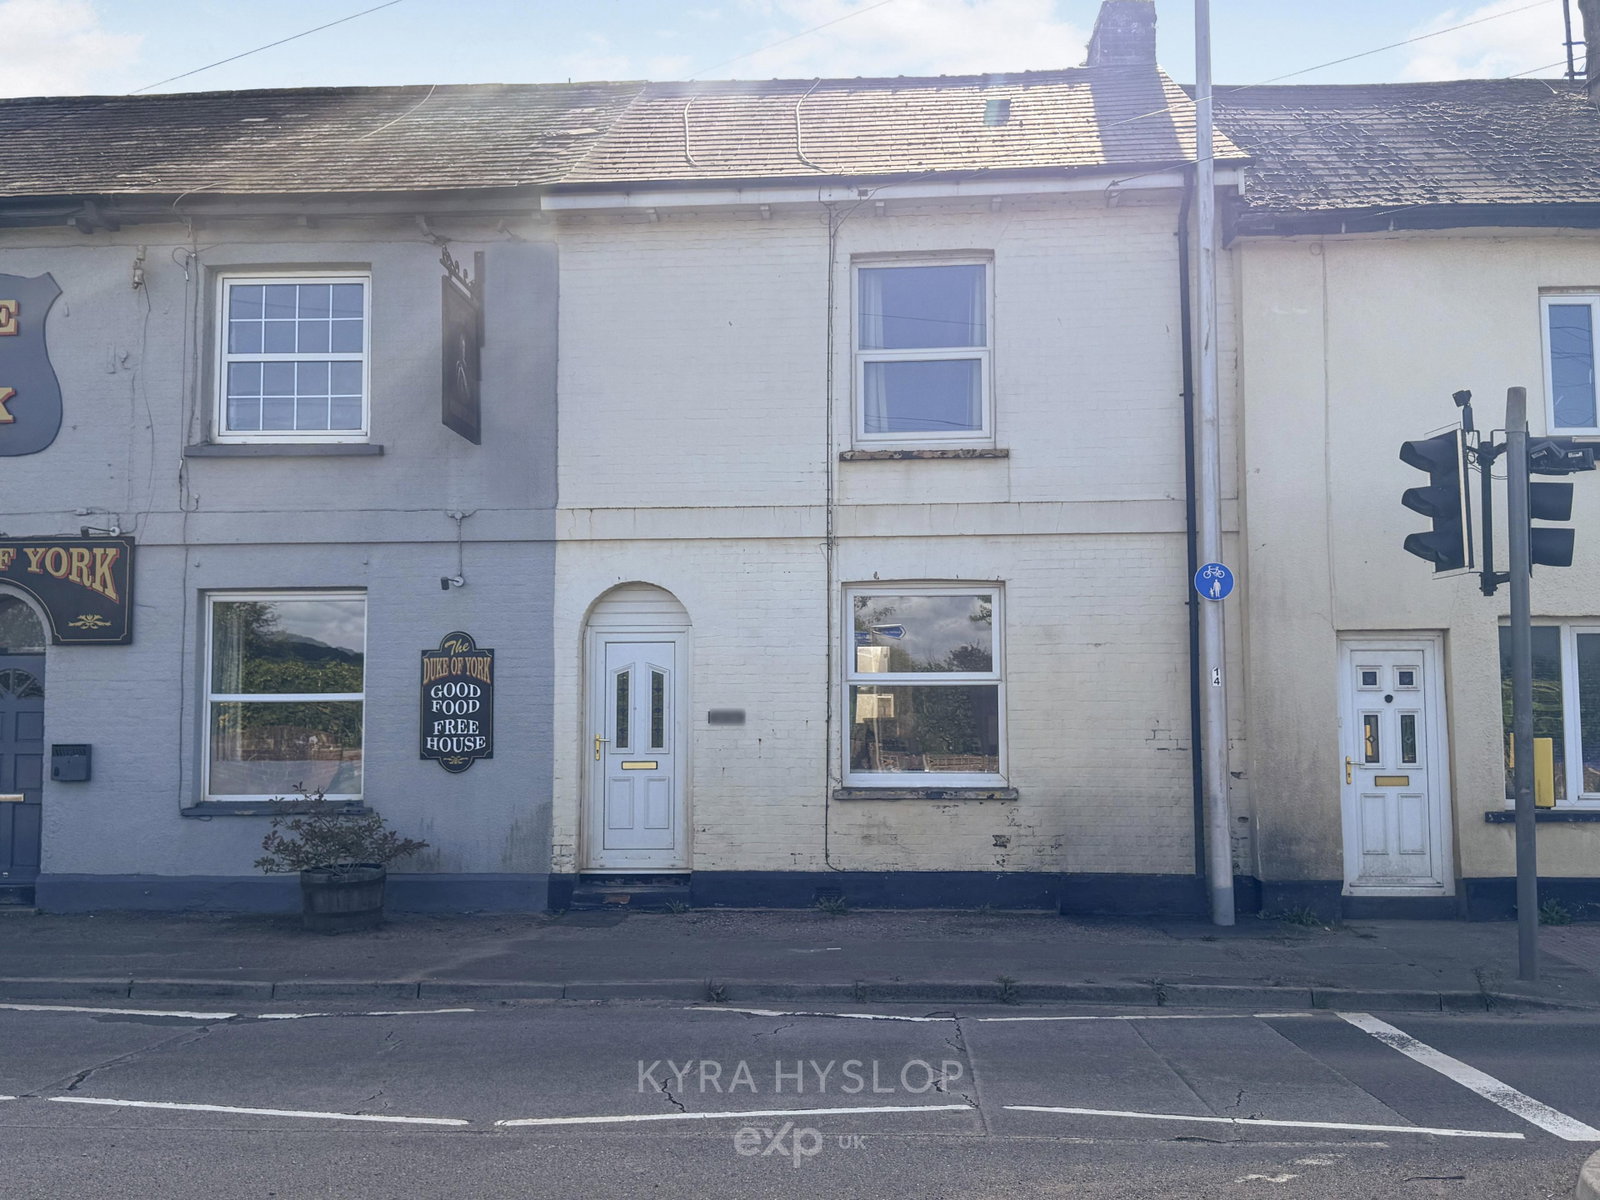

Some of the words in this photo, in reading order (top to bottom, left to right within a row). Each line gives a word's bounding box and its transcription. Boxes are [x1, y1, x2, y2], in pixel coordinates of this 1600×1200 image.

[23, 547, 120, 604] YORK
[445, 639, 470, 656] The
[423, 657, 449, 684] DUKE
[450, 657, 464, 676] OF
[465, 656, 492, 684] YORK
[430, 682, 481, 699] GOOD
[431, 700, 480, 715] FOOD
[433, 719, 479, 735] FREE
[426, 736, 486, 753] HOUSE
